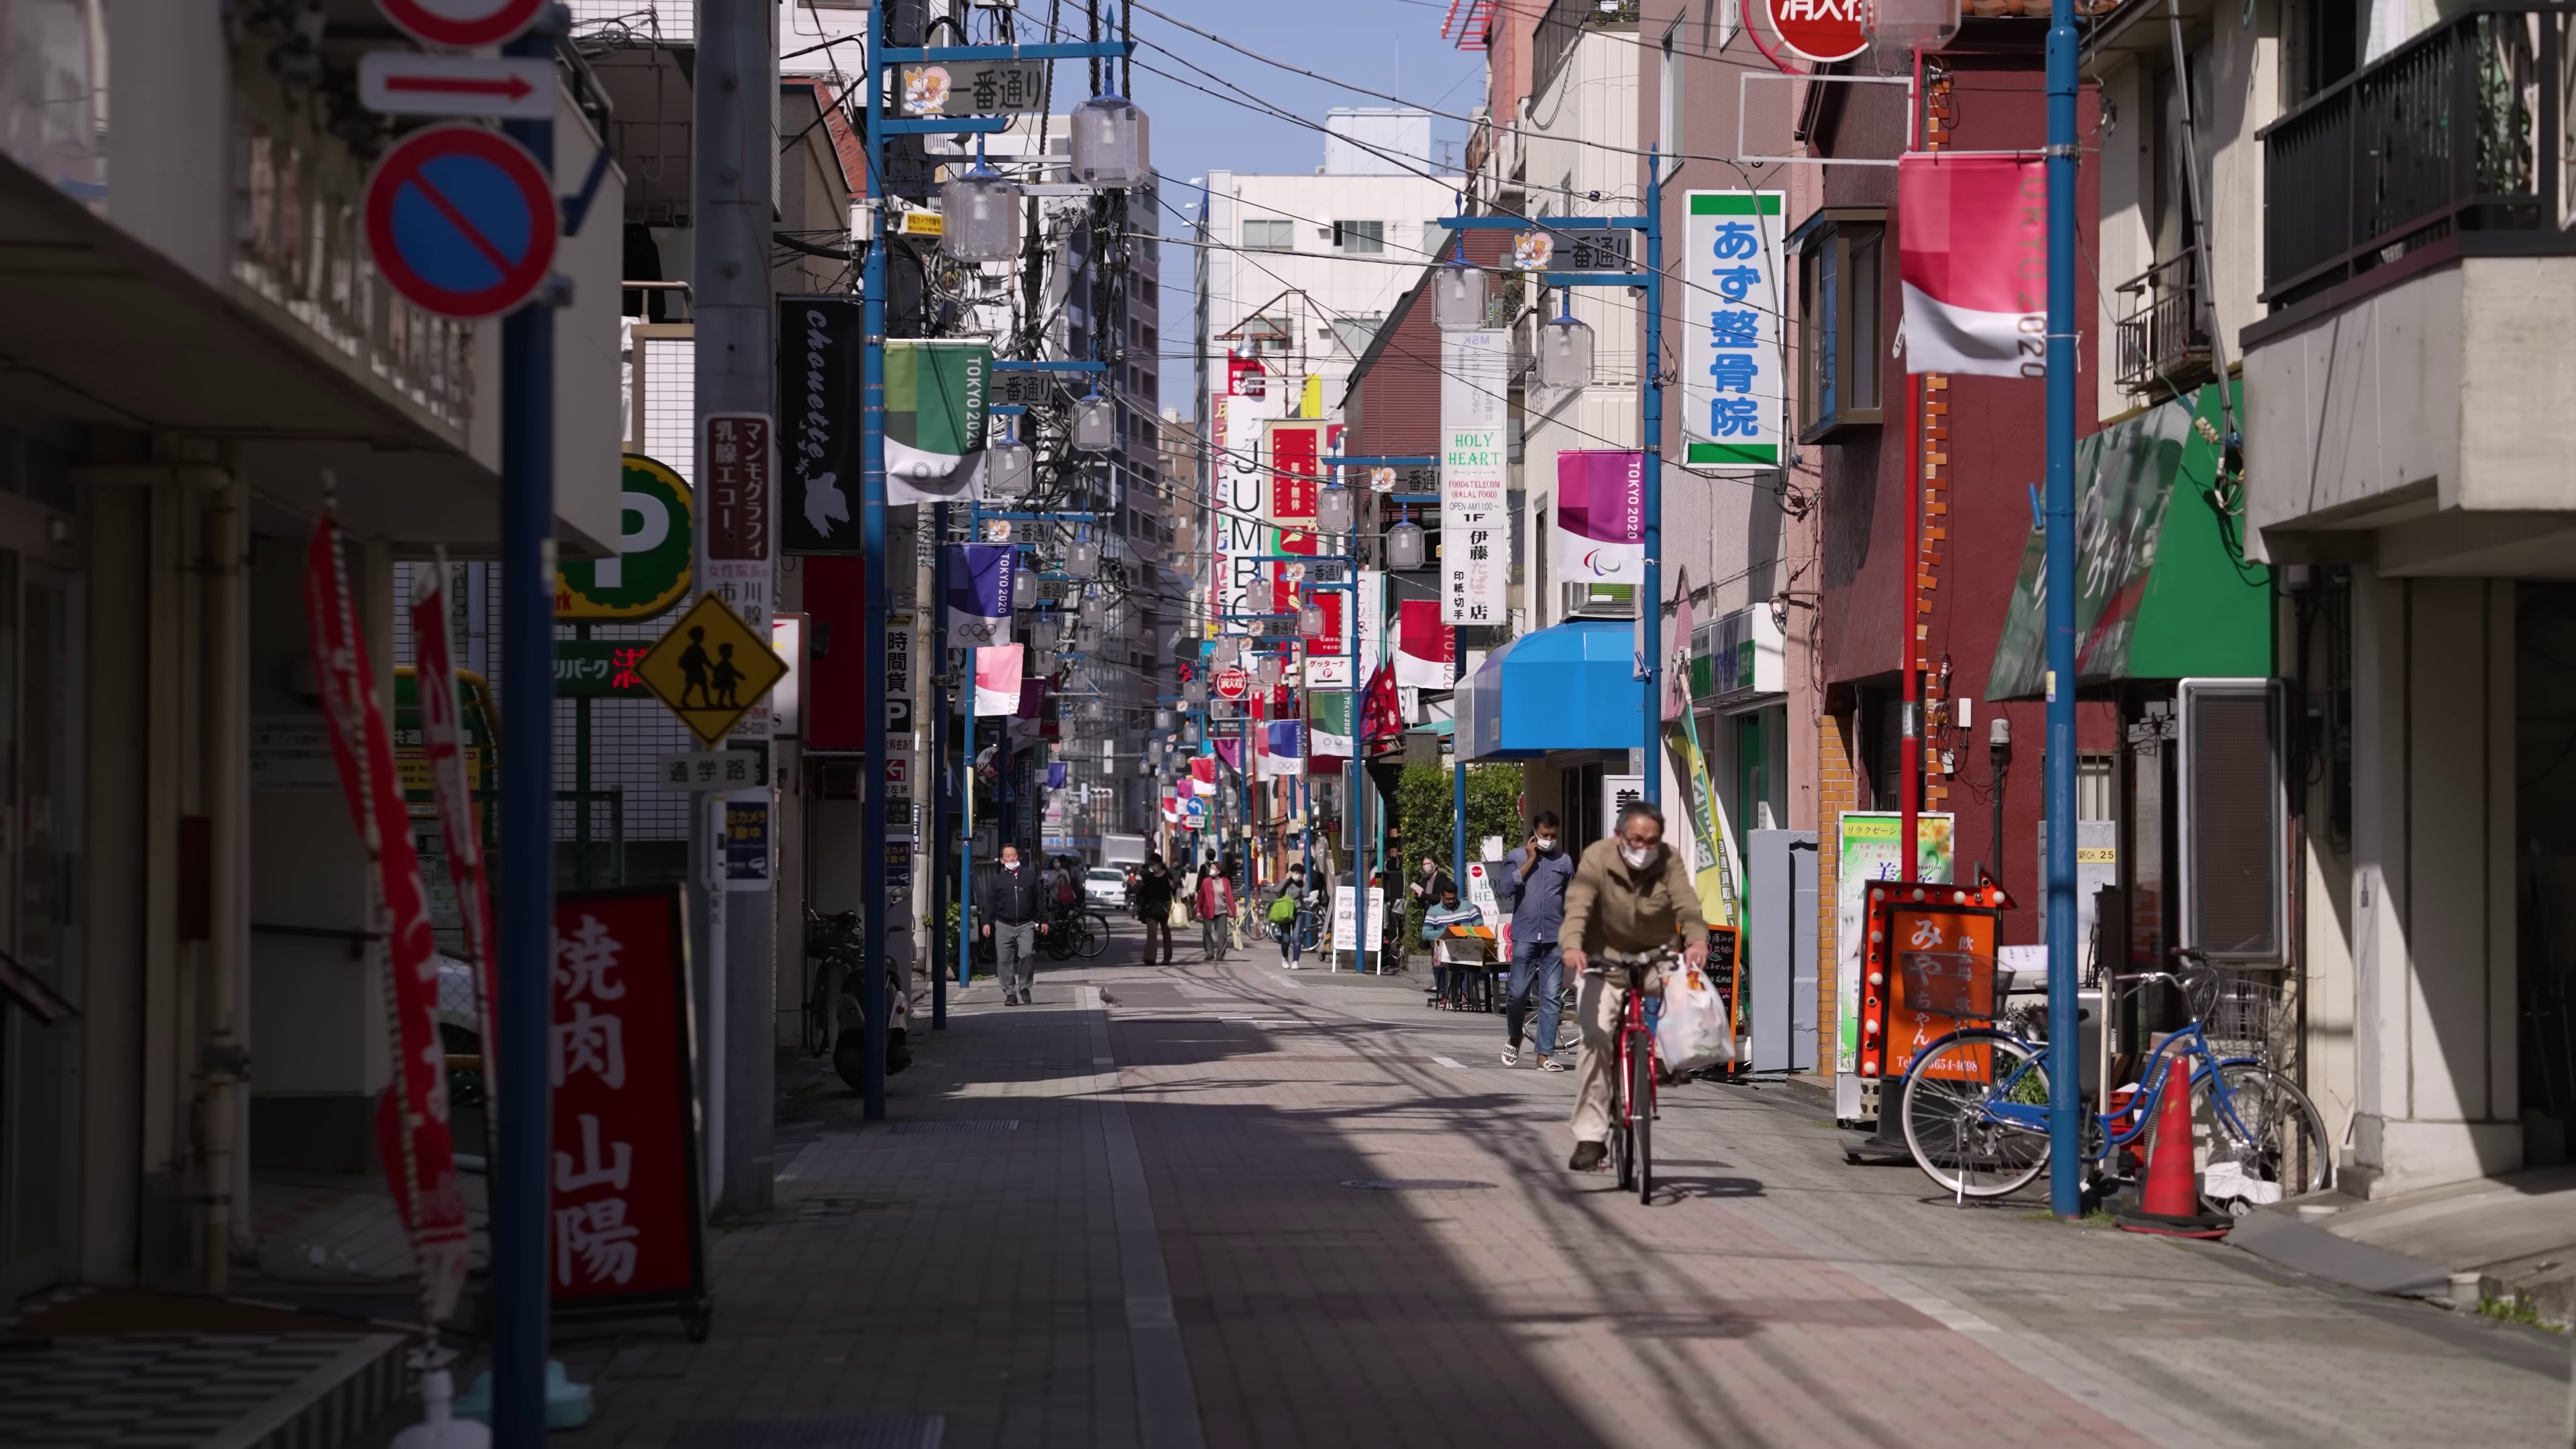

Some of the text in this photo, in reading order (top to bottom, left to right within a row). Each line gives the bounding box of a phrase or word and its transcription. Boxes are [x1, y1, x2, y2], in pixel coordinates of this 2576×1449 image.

[951, 69, 1040, 109] 一番通り
[1554, 236, 1629, 268] 一番通り
[1710, 221, 1761, 437] あず整骨院
[806, 309, 833, 458] chomette
[991, 376, 1052, 402] 一番通り
[1232, 380, 1262, 394] SOT
[966, 357, 981, 449] TOKYO 2020
[1455, 432, 1495, 447] HOLY
[1449, 452, 1501, 466] HEART
[714, 420, 738, 529] 乳腺エコー
[1449, 480, 1501, 488] FOOD&TELECOM
[743, 422, 763, 557] マンモグラフィ
[1478, 490, 1497, 498] FOOD)
[1450, 502, 1466, 511] OPEN
[1627, 462, 1640, 539] TOKYO 2020
[1463, 514, 1485, 522] 1F
[1011, 524, 1055, 542] 一番通り
[1305, 564, 1342, 581] 一番通り
[998, 553, 1010, 614] TOKYO 2020
[886, 631, 908, 692] 時間貸
[1444, 655, 1456, 690] 2020
[1221, 678, 1243, 689] 消火栓
[886, 739, 913, 751] 料金あり
[669, 759, 745, 783] 通学路
[886, 802, 907, 811] 小岩
[956, 832, 984, 843] cfe
[2100, 851, 2114, 859] 25
[1474, 891, 1514, 902] HEAR
[1910, 919, 1943, 1045] みやちゃん
[552, 913, 641, 1287] 焼肉 山陽
